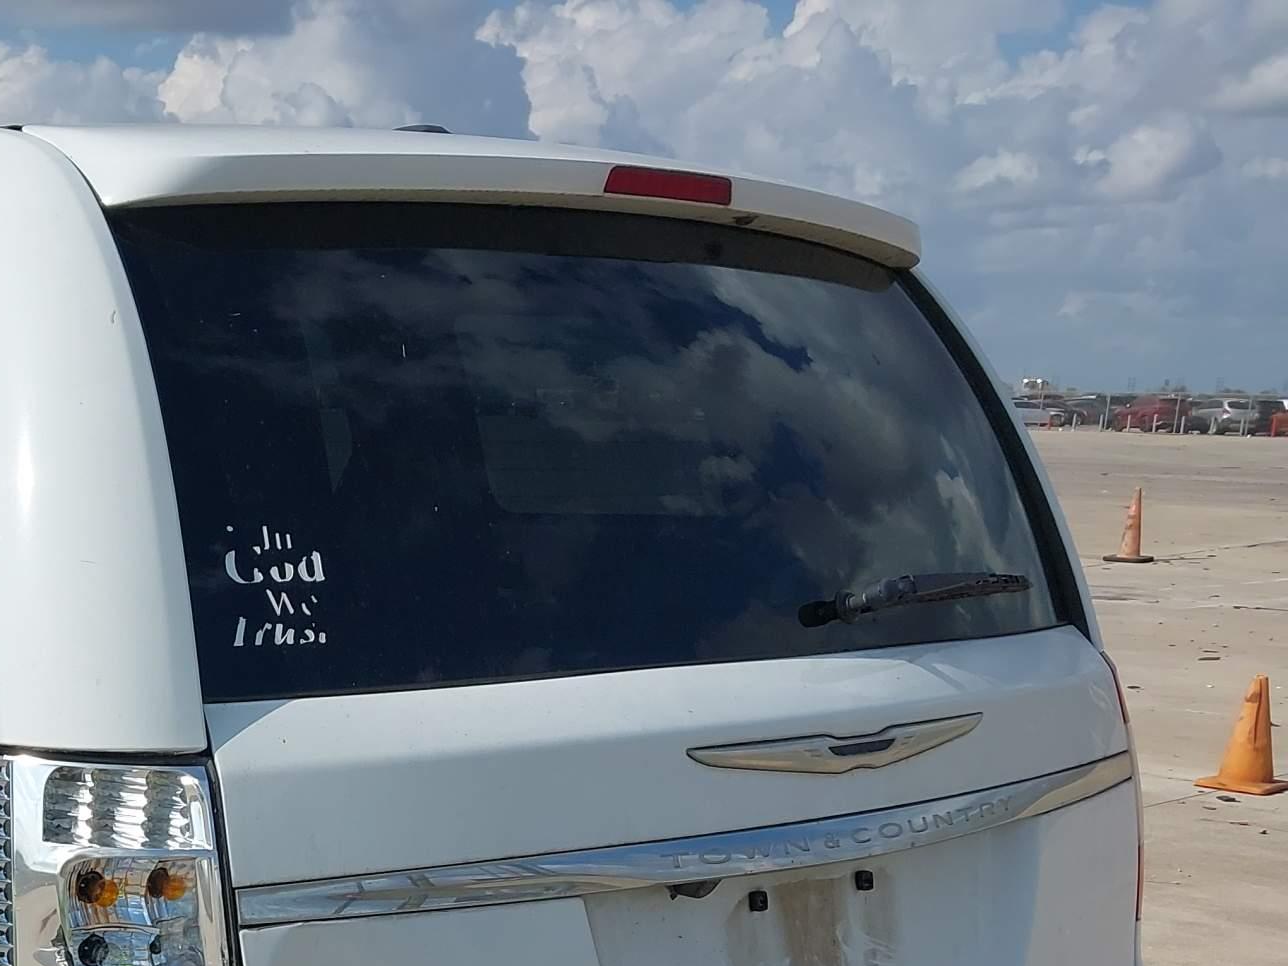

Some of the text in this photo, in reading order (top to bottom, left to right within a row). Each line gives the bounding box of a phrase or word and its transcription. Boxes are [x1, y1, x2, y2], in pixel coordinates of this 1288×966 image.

[660, 794, 1014, 869] TOWN & COUNTRY
